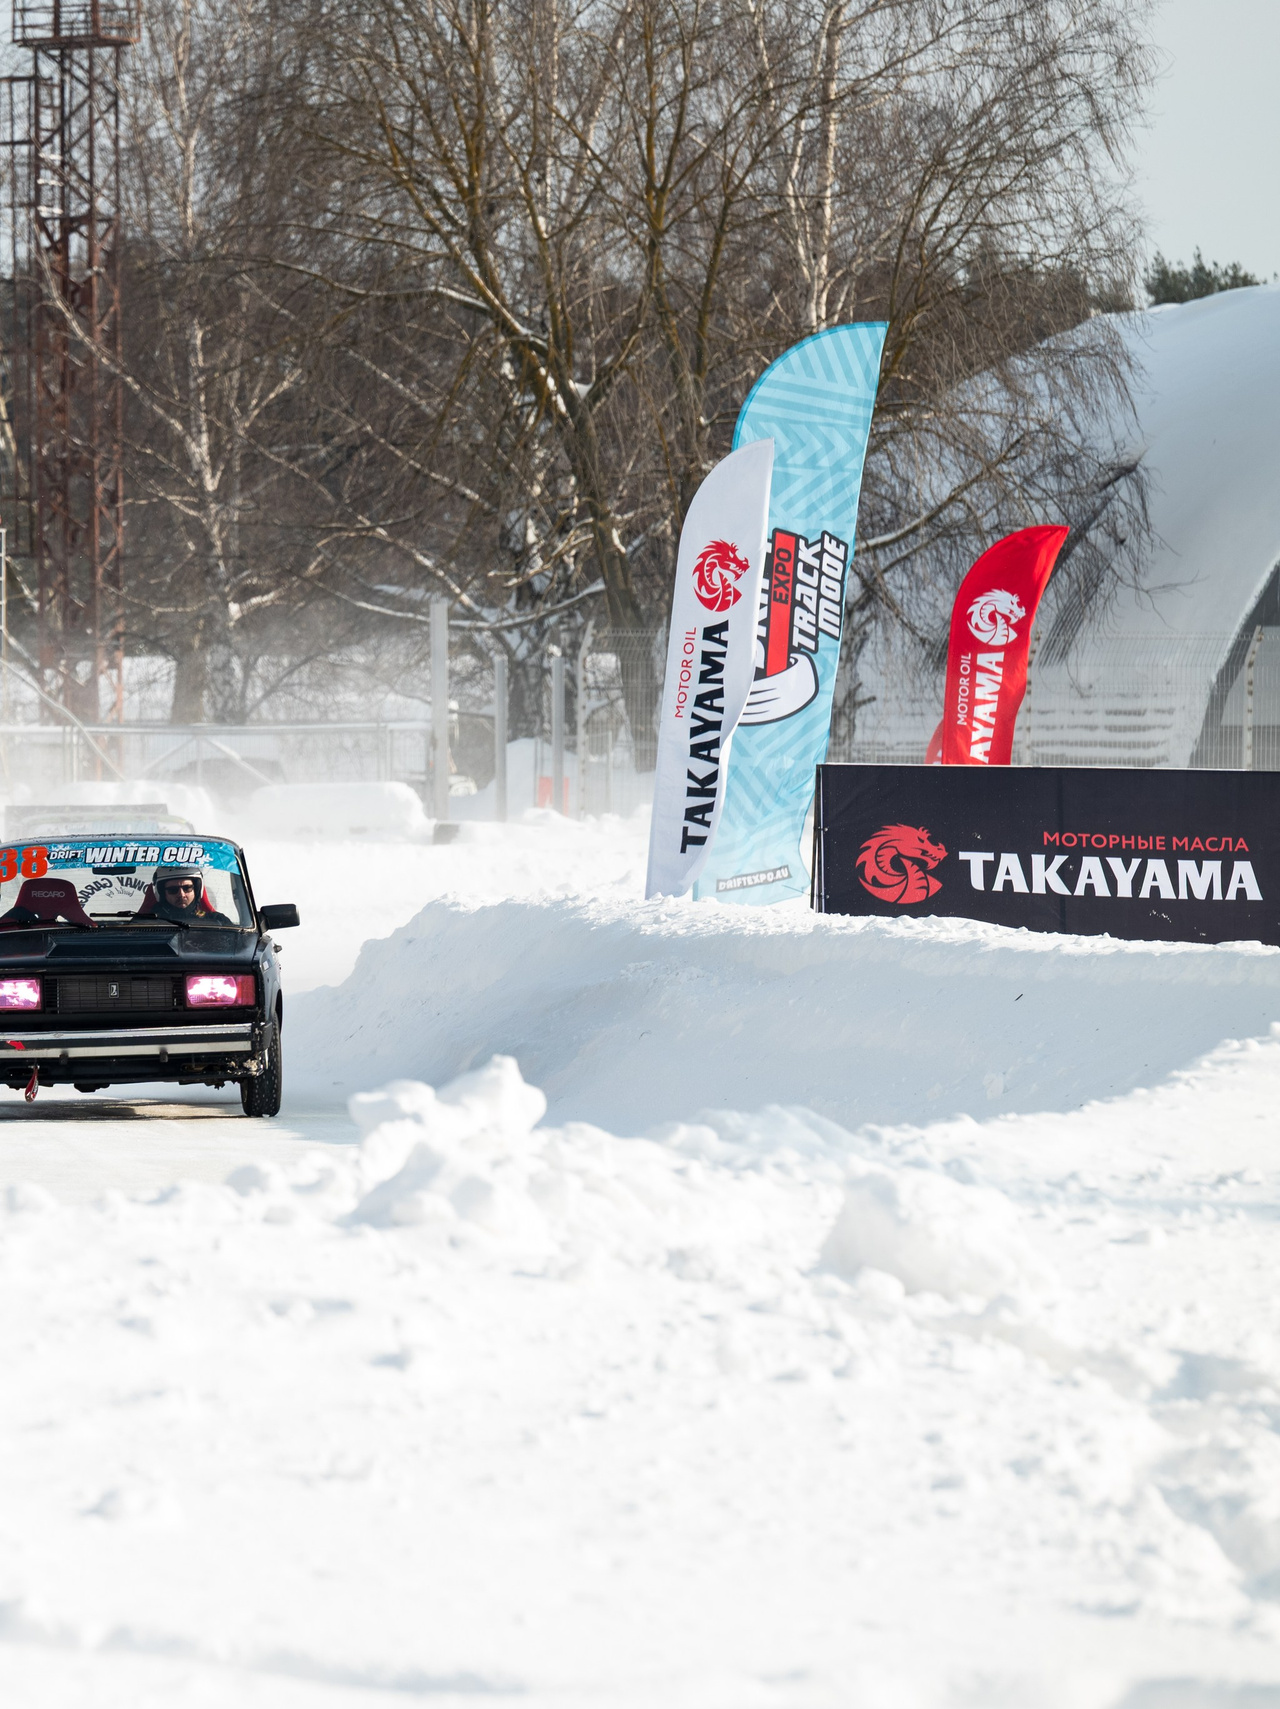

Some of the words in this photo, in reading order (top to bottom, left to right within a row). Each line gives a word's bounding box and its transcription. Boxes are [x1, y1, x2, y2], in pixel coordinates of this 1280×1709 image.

[772, 547, 792, 606] EXPO
[792, 537, 821, 651] TRACK
[818, 533, 846, 639] MODE
[683, 626, 697, 652] OIL
[960, 652, 971, 674] OIL
[674, 658, 694, 719] MOTOR
[956, 677, 970, 726] MOTOR
[969, 651, 1005, 765] AYAMA
[680, 619, 729, 854] TAKAYAMA
[49, 850, 84, 860] DRIFT
[85, 846, 160, 863] WINTER
[163, 847, 203, 863] CUP
[1043, 831, 1166, 850] МОТОРНЫЕ
[1172, 836, 1249, 852] МАСЛА
[31, 890, 66, 898] RECARO
[958, 851, 1264, 901] TAKAYAMA
